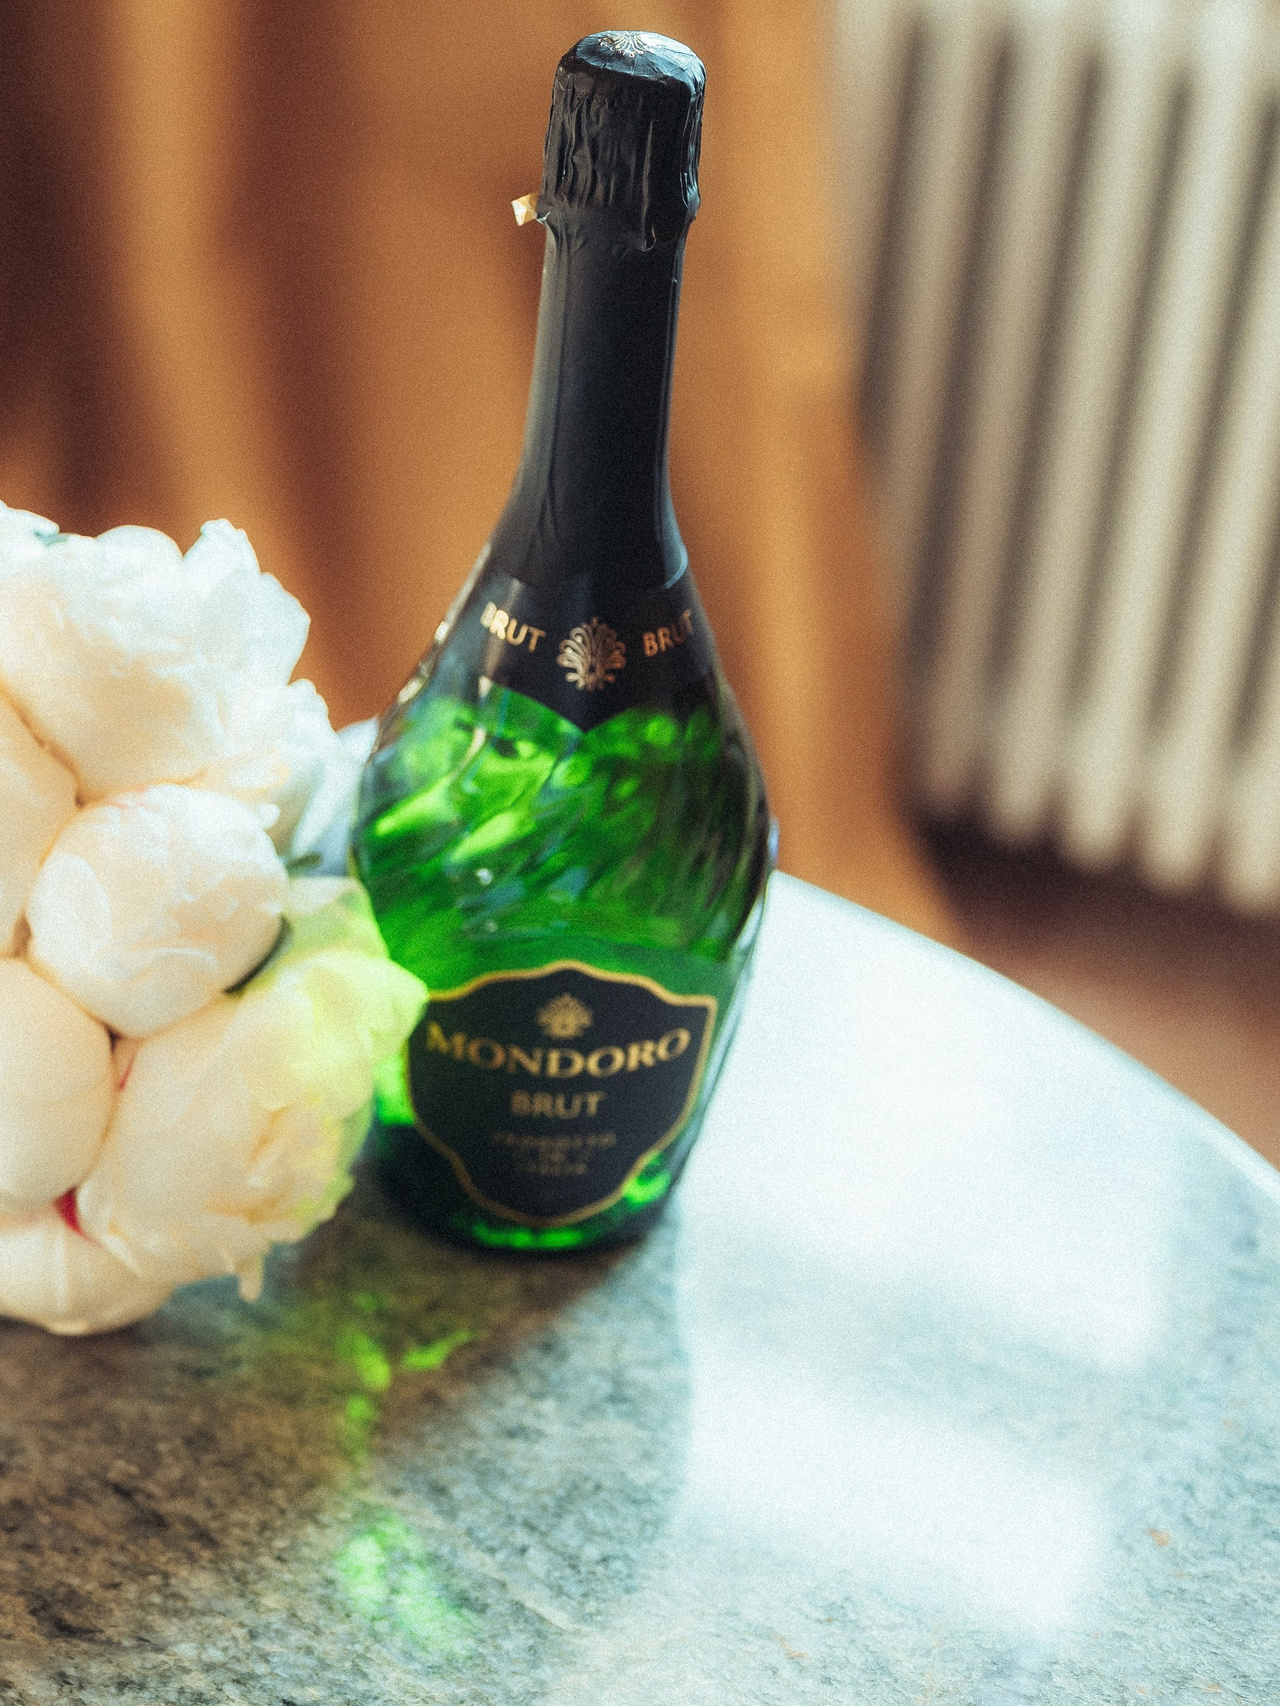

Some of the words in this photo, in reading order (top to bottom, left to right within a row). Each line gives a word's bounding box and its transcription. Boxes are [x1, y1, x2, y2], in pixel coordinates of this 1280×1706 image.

[480, 601, 546, 652] BRUT
[642, 608, 694, 657] BRUT
[426, 1020, 691, 1079] MONDORO
[510, 1089, 606, 1120] BRUT
